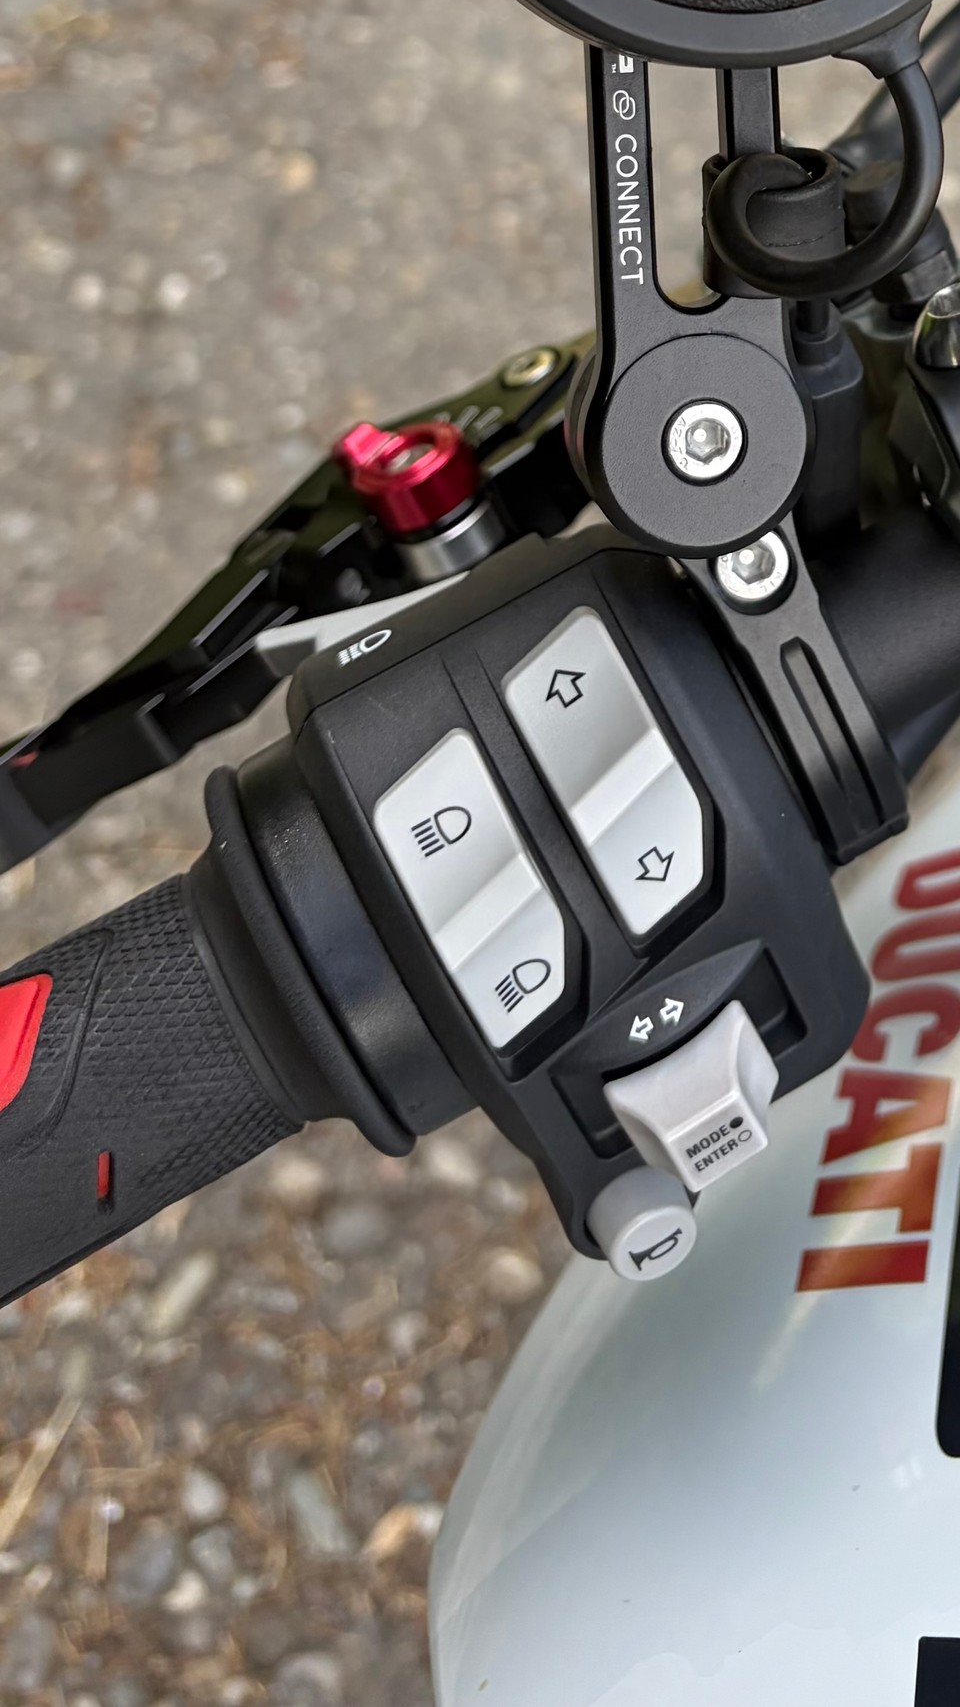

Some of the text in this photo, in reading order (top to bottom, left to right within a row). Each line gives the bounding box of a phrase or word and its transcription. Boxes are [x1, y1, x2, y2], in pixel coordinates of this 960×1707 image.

[615, 133, 644, 285] CONNECT
[685, 1124, 731, 1159] MODE
[693, 1138, 739, 1172] ENTER
